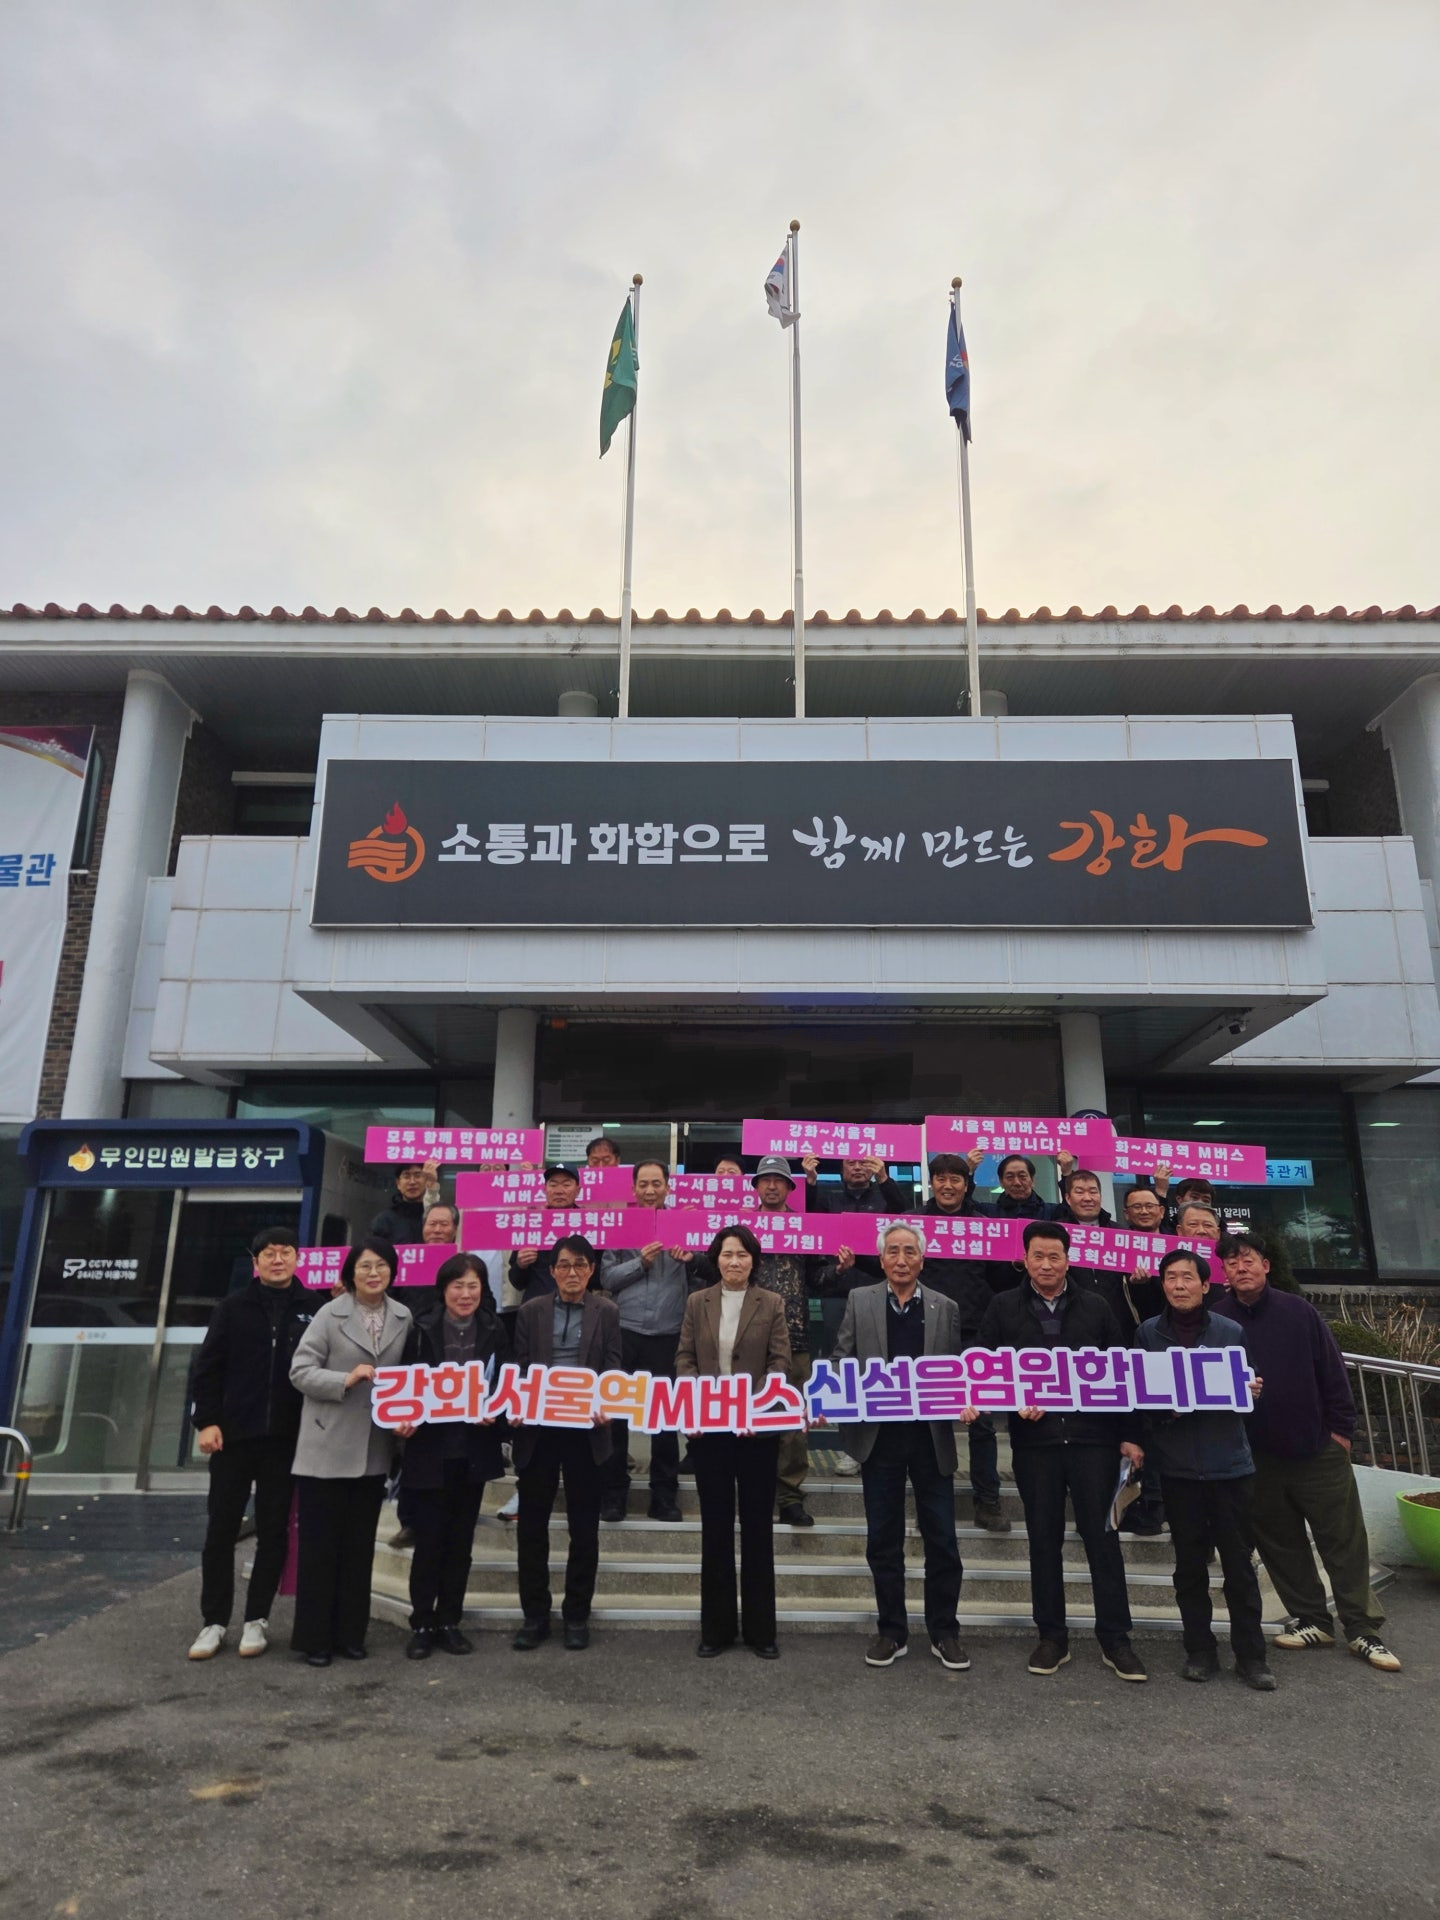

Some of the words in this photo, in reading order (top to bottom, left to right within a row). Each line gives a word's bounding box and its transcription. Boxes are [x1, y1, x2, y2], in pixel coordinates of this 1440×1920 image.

[438, 822, 577, 865] 소통과
[587, 821, 769, 866] 화합으로
[793, 815, 906, 869] 함께
[922, 824, 1034, 868] 만드는
[1048, 809, 1269, 876] 강화
[0, 853, 57, 887] 물관
[788, 1123, 876, 1141] 강화~서울역
[950, 1119, 995, 1134] 서울역
[1003, 1121, 1049, 1135] M버스
[1057, 1121, 1088, 1136] 신설
[386, 1130, 416, 1144] 모두
[423, 1130, 453, 1145] 함께
[459, 1131, 525, 1145] 만들어요!
[976, 1136, 1062, 1152] 응원합니다!
[386, 1145, 473, 1161] 강화~서울역
[480, 1147, 523, 1161] M버스
[770, 1139, 813, 1154] M버스
[821, 1141, 850, 1156] 신설
[858, 1142, 895, 1157] 기원!
[1115, 1139, 1190, 1158] 화~서울역
[1198, 1146, 1245, 1162] M버스
[100, 1147, 285, 1169] 무인민원발급창구
[1265, 1164, 1308, 1179] 족관계
[668, 1177, 734, 1193] 화~서울역
[495, 1212, 543, 1228] 강화군
[551, 1211, 623, 1227] 교통혁신!
[1223, 1207, 1251, 1223] 알리미
[934, 1219, 1009, 1238] 교통혁신!
[511, 1231, 558, 1246] M버스
[685, 1232, 716, 1246] M버
[783, 1234, 823, 1250] 기원!
[1114, 1233, 1167, 1254] 미래를
[951, 1239, 992, 1256] 신설!
[88, 1259, 113, 1269] CCTV
[1068, 1247, 1126, 1268] 통혁신!
